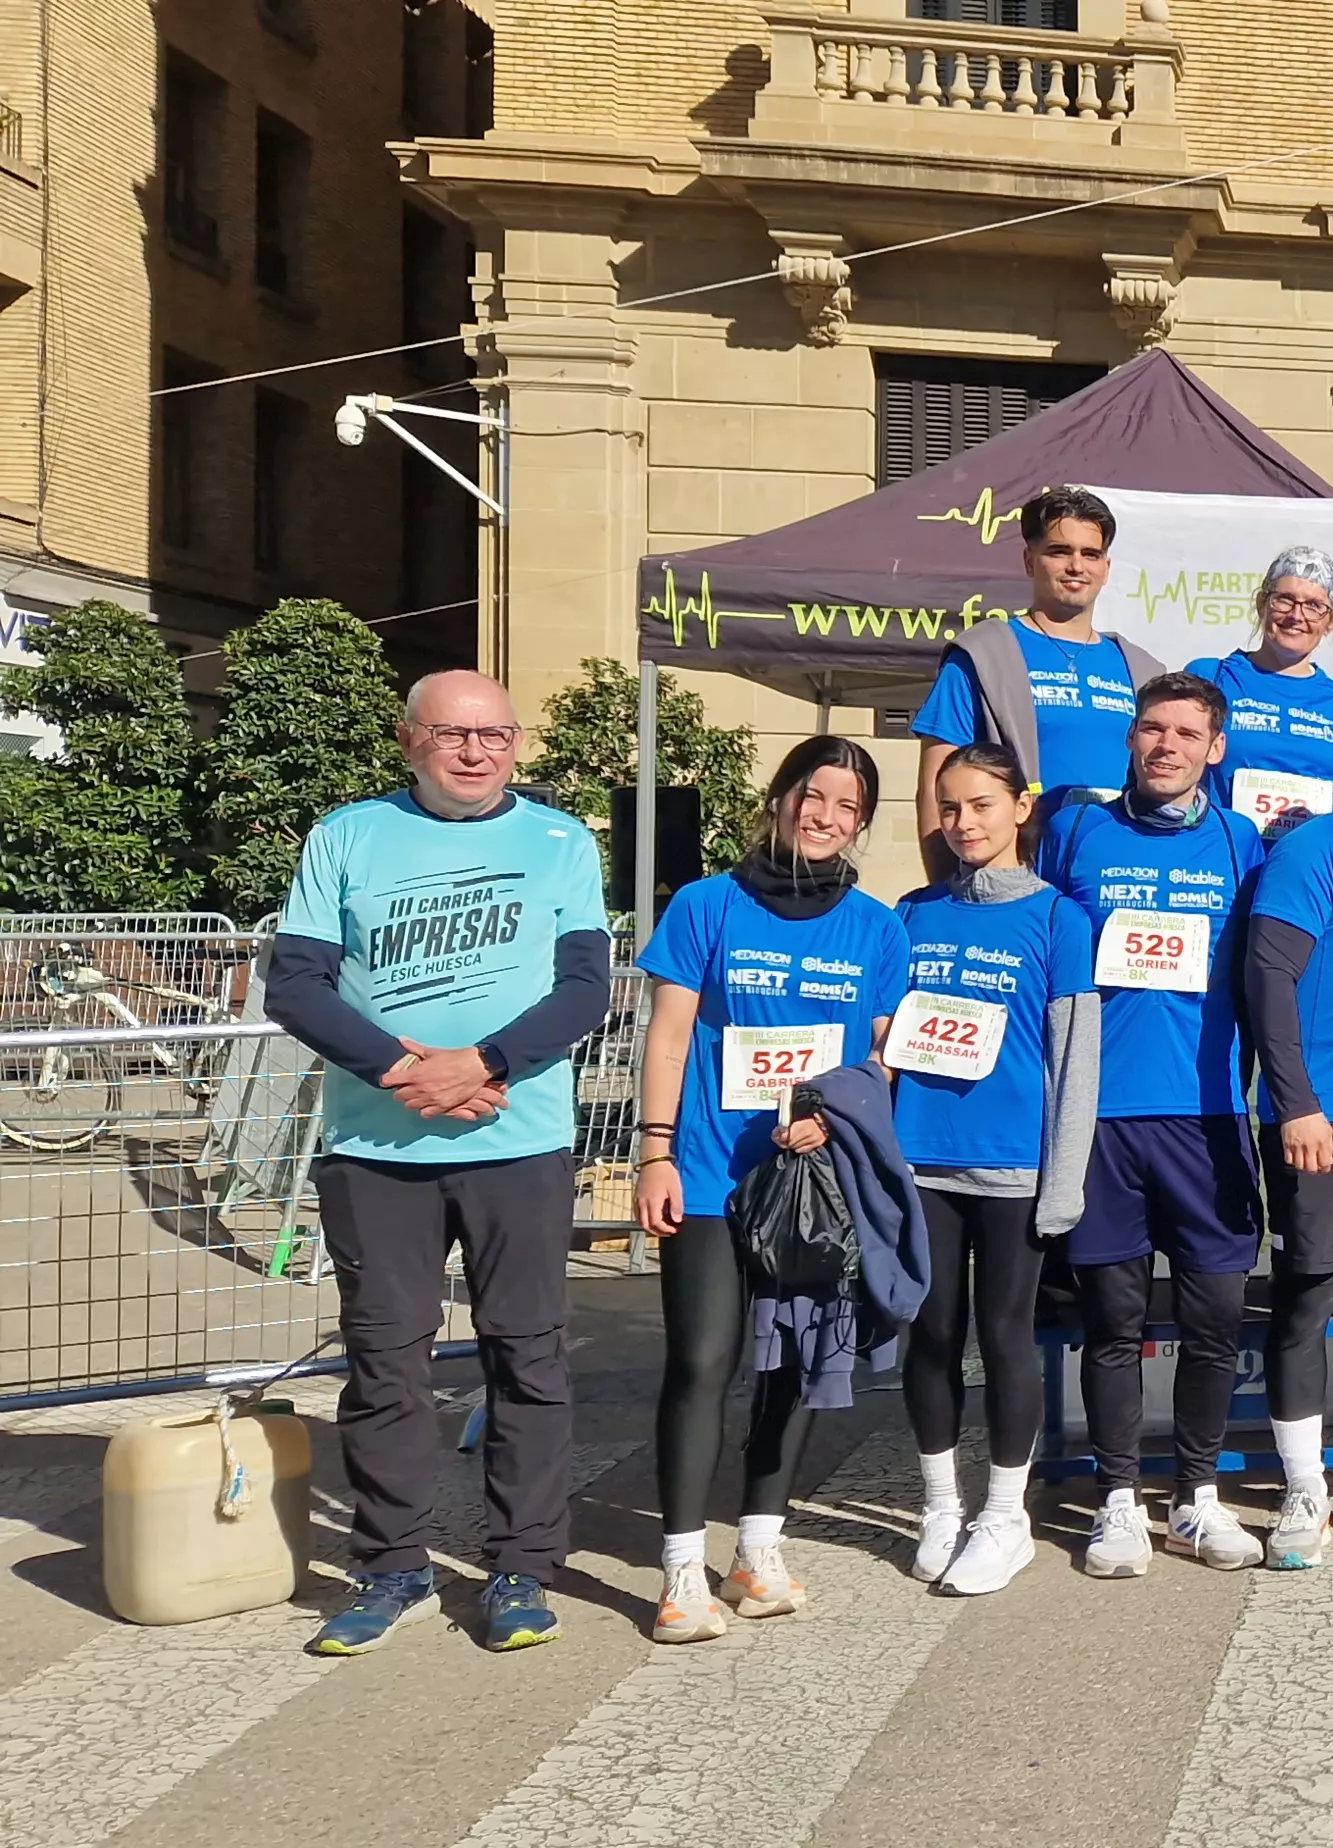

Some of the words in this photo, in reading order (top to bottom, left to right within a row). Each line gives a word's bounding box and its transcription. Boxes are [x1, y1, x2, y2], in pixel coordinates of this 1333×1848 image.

[1030, 685, 1079, 700] NEXT
[1231, 712, 1280, 727] NEXT
[1254, 794, 1308, 818] 522
[1101, 867, 1159, 878] MEDIAZION
[1183, 869, 1225, 887] kablex
[1100, 885, 1157, 900] NEXT
[388, 897, 414, 920] III
[418, 887, 493, 914] CARRERA
[370, 901, 523, 972] EMPRESAS
[1124, 932, 1184, 957] 529
[817, 959, 863, 976] kablex
[979, 947, 1023, 968] kablex
[1127, 958, 1178, 970] LORIEN
[390, 964, 420, 983] ESIC
[424, 953, 482, 975] HUESCA
[728, 968, 790, 988] NEXT
[1128, 969, 1149, 981] 8K
[919, 1016, 979, 1046] 422
[907, 1040, 980, 1060] HADASSAH
[917, 1053, 936, 1065] 8K
[751, 1049, 815, 1074] 527
[1233, 1350, 1264, 1395] 2
